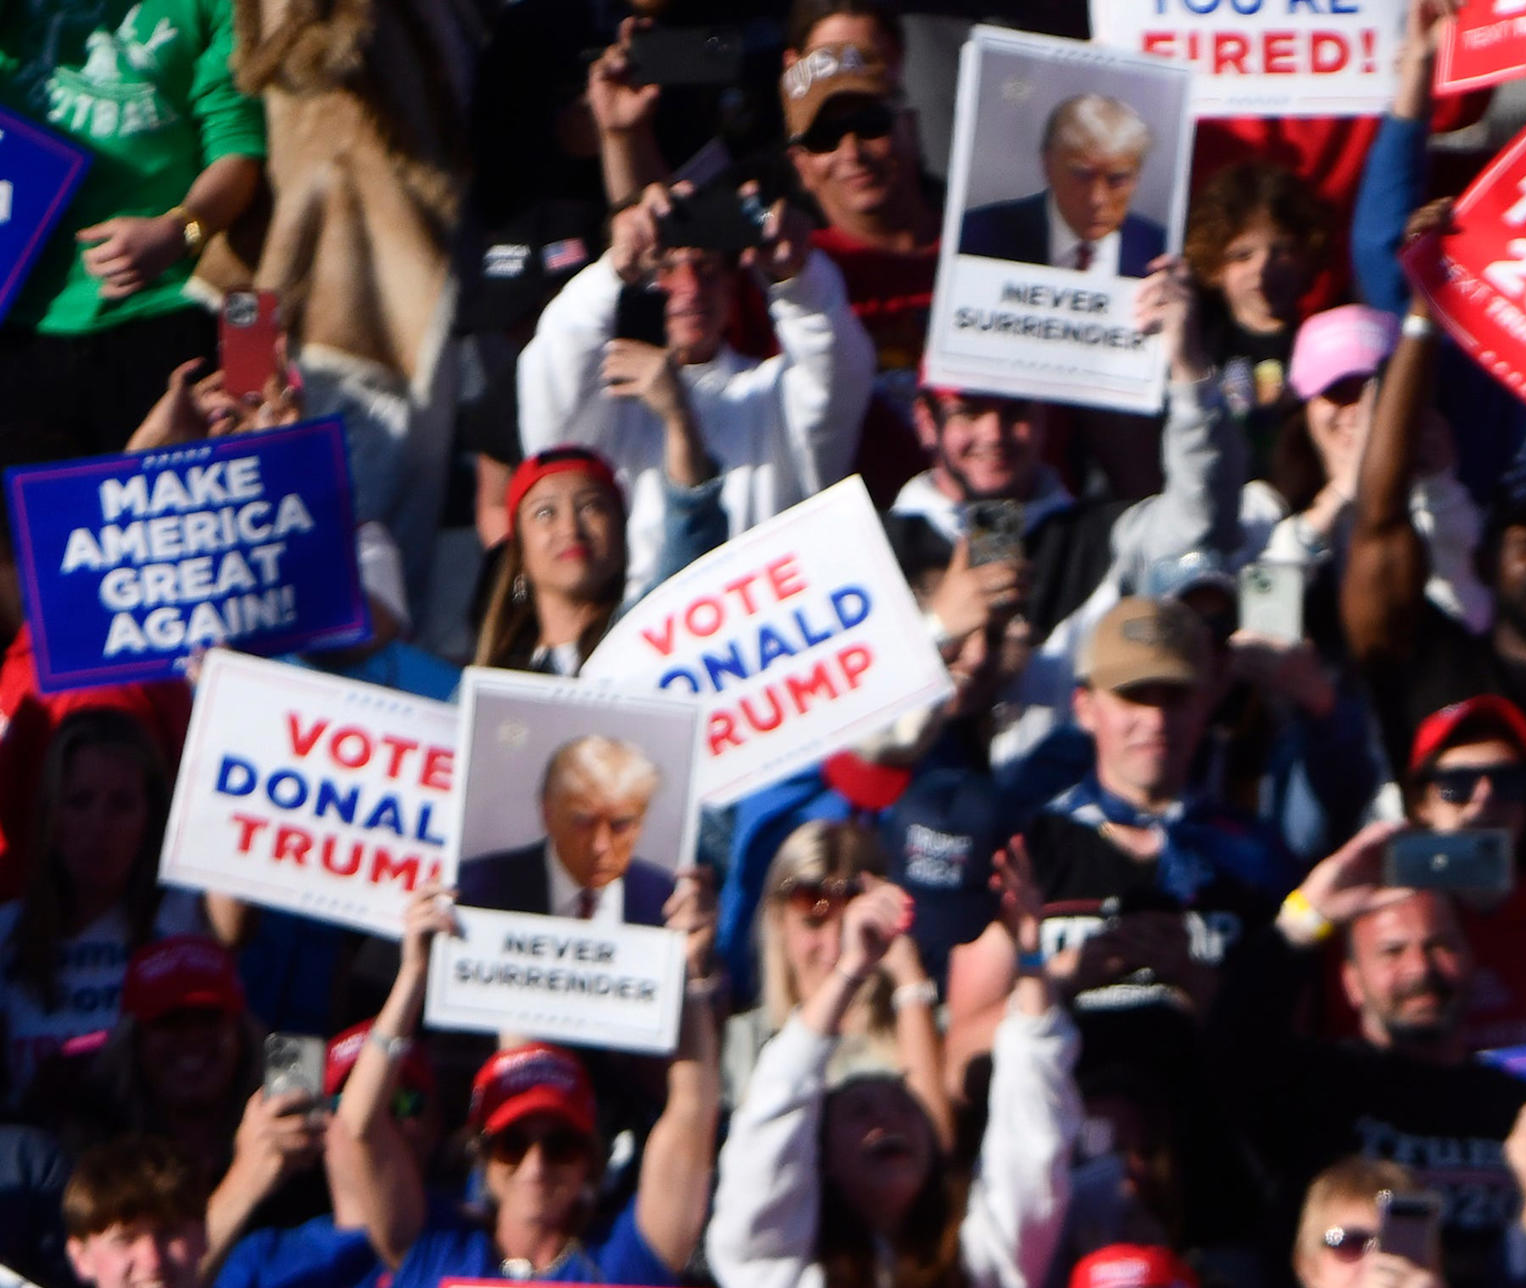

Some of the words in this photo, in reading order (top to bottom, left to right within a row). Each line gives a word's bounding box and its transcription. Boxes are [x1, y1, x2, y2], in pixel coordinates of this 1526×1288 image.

[954, 304, 1148, 352] SURRENDER
[1002, 278, 1110, 316] NEVER
[99, 456, 262, 521] MAKE
[61, 492, 313, 573] AMERICA
[102, 541, 286, 611] GREAT
[639, 552, 810, 657] VOTE
[103, 584, 297, 657] AGAIN!
[706, 643, 876, 757] RUMP
[286, 708, 455, 792] VOTE
[214, 753, 446, 848] DONAL
[228, 813, 442, 893] TRUM
[454, 957, 658, 1004] SURRENDER
[502, 931, 619, 967] NEVER
